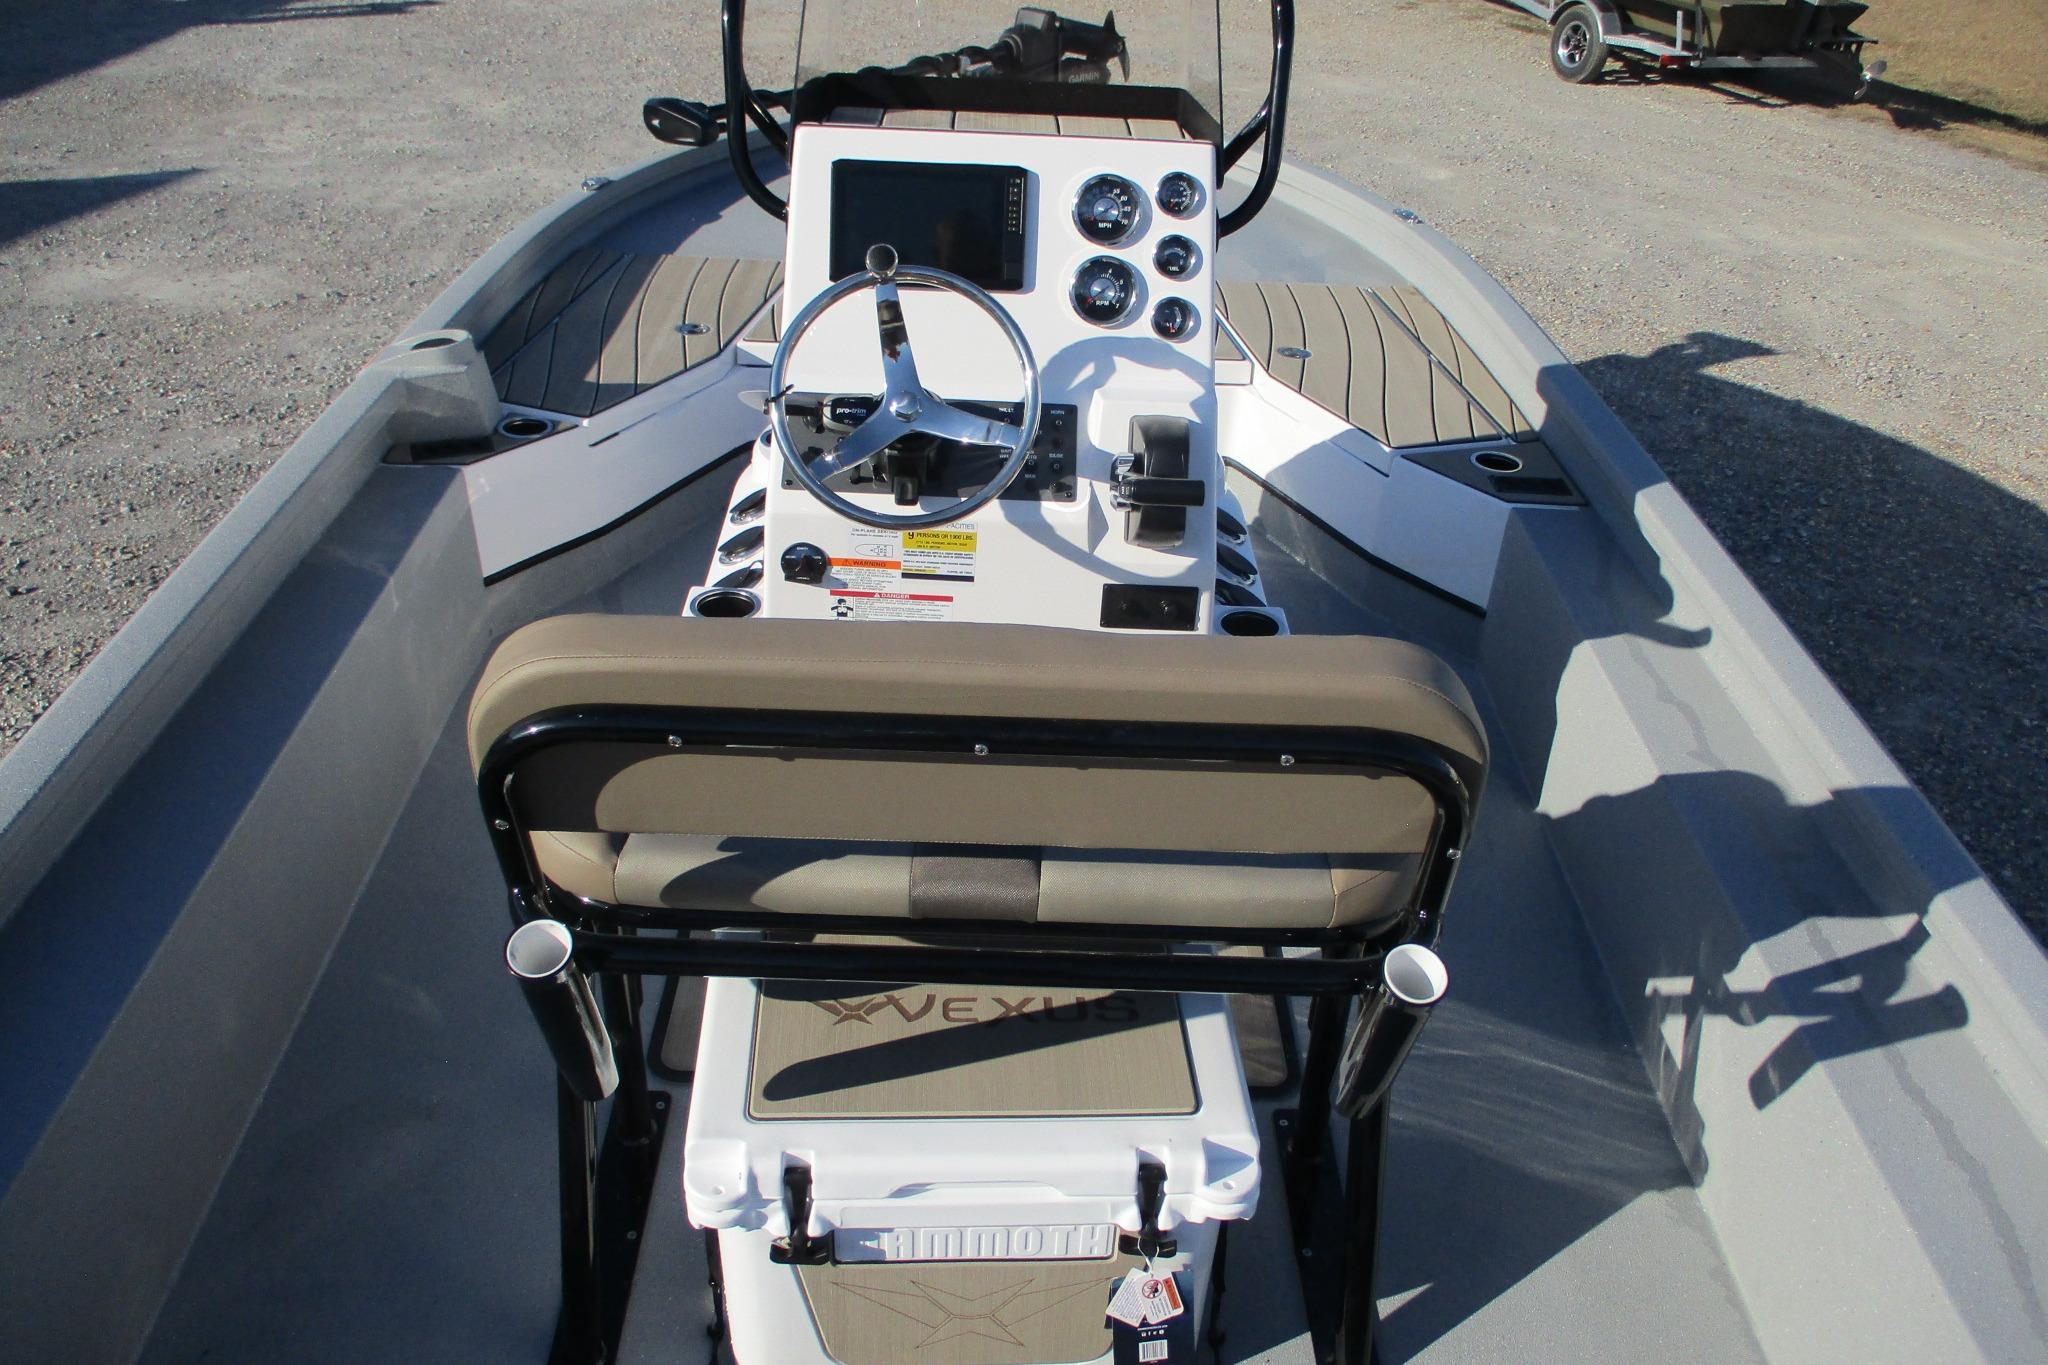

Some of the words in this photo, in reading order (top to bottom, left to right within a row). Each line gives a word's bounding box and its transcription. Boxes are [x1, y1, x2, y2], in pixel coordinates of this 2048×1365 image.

[853, 560, 886, 568] WARNING
[881, 592, 910, 600] DANGER
[884, 992, 1140, 1024] VEXUS
